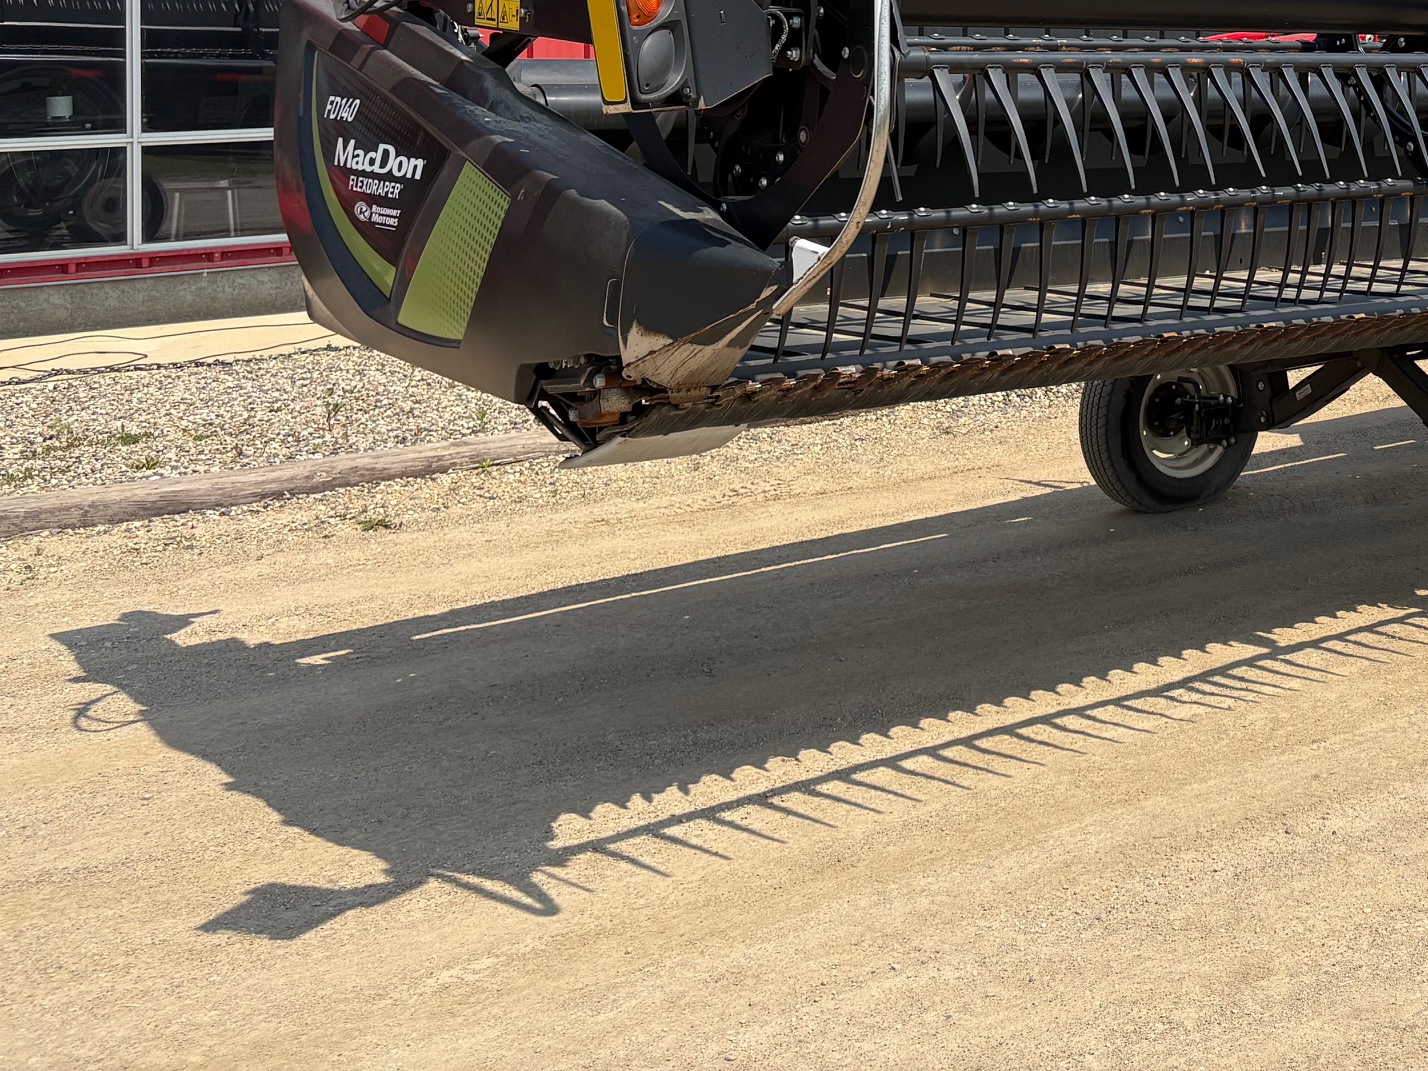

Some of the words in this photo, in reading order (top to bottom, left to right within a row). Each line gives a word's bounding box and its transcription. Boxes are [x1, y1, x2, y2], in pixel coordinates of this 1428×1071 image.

[324, 95, 361, 122] FD140
[334, 137, 424, 180] MacDon
[349, 175, 401, 199] FLEXDRAPER
[371, 213, 399, 226] MOTORS
